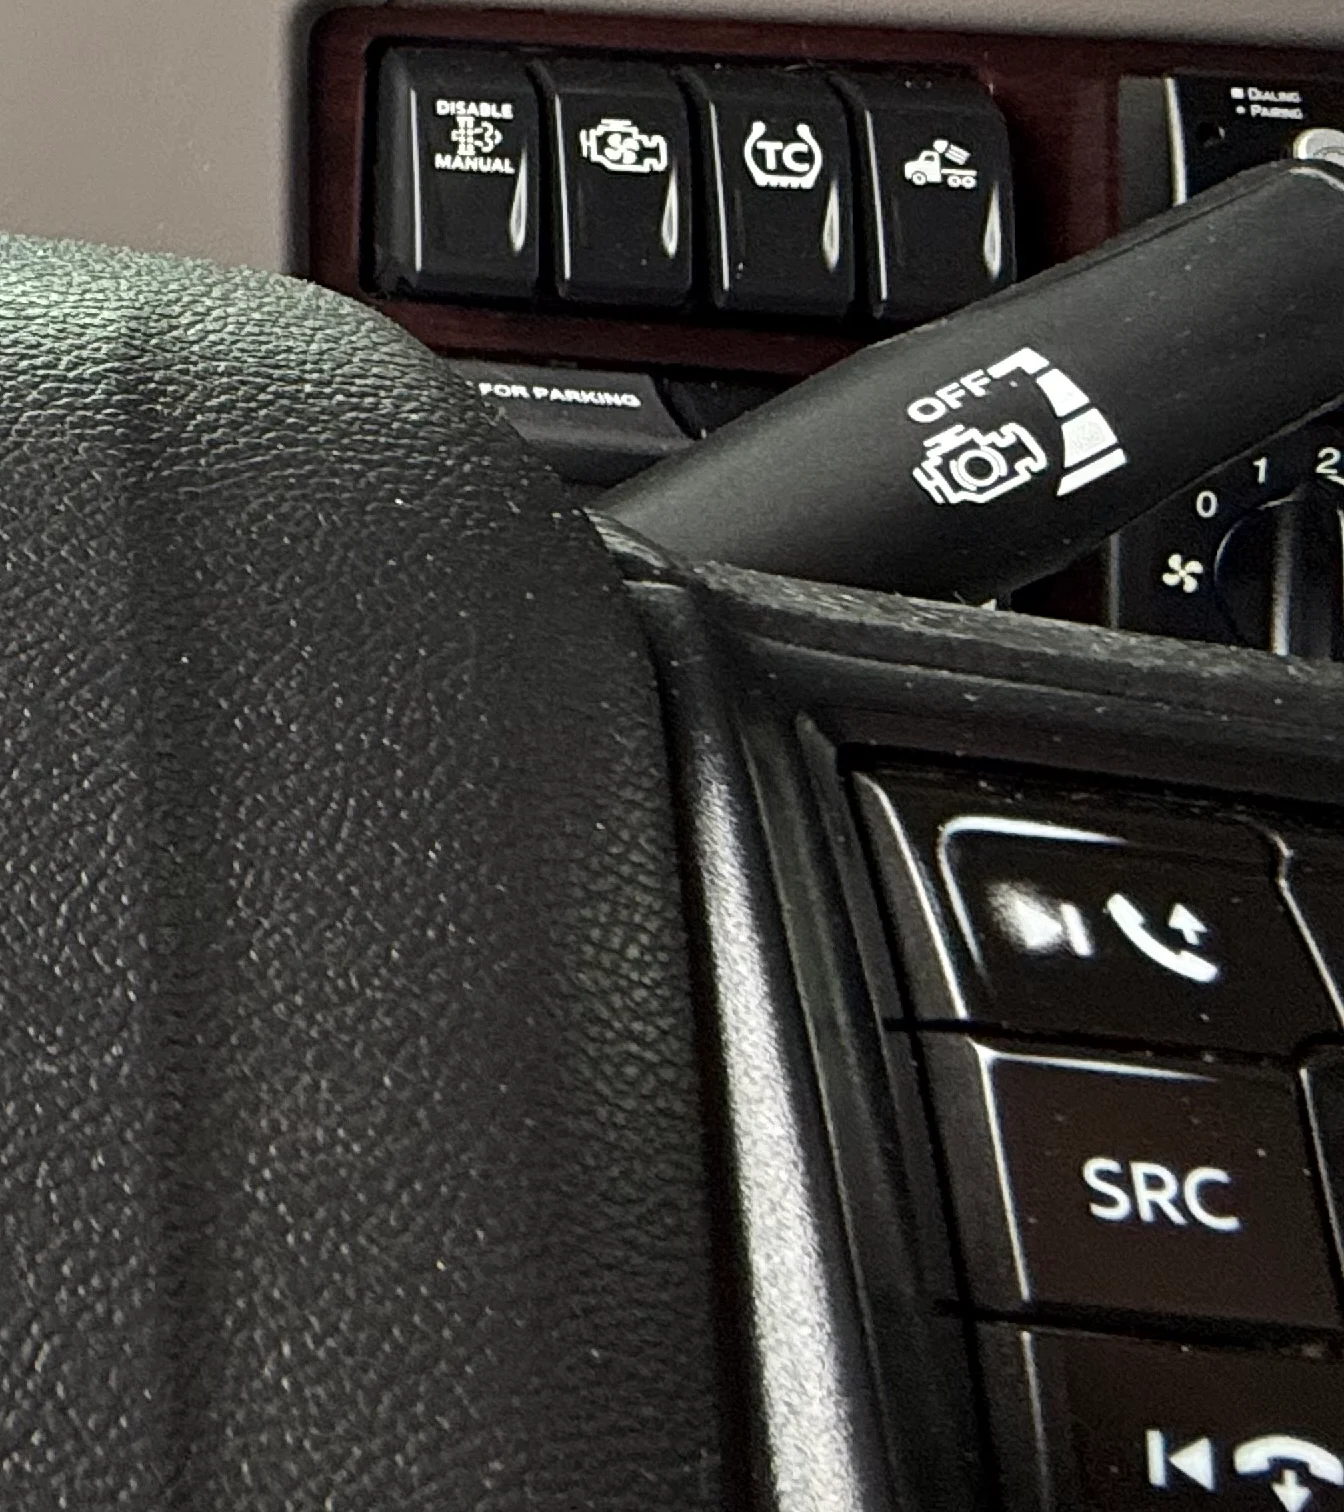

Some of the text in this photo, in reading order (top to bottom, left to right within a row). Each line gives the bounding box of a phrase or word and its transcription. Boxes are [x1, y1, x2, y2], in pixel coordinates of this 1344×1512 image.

[436, 99, 513, 119] DISABLE
[434, 153, 515, 175] MANUAL
[755, 140, 811, 173] TC
[478, 382, 642, 408] FOR PARKING
[906, 367, 992, 424] OFF
[1196, 446, 1342, 518] 0 1 2
[1082, 1157, 1242, 1232] SRC
